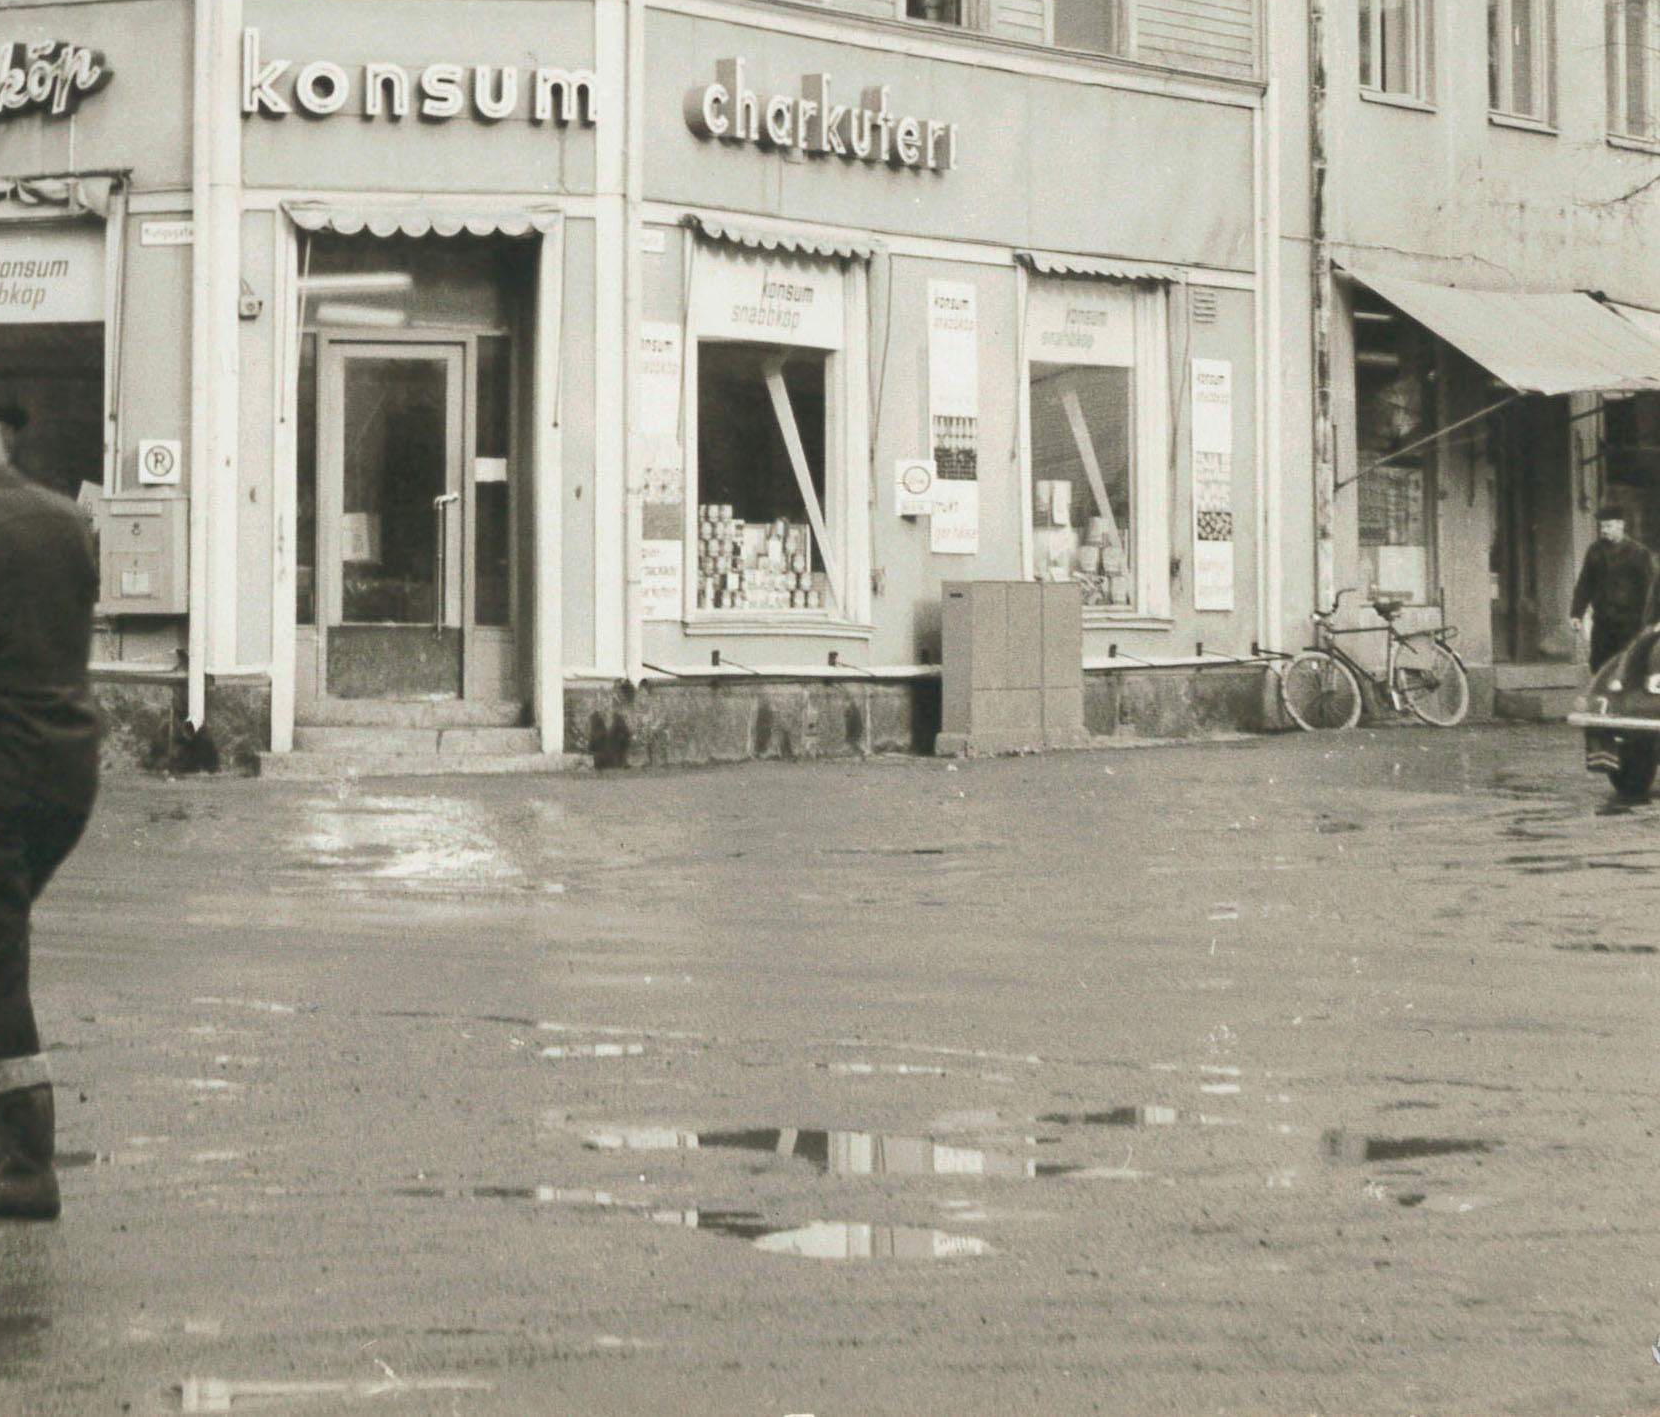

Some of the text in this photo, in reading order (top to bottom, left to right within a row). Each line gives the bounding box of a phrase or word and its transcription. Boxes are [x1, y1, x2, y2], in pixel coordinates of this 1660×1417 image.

[240, 26, 597, 124] konsum
[698, 57, 960, 170] charkuteri
[762, 268, 814, 303] konsum
[933, 290, 969, 311] konsum
[1065, 302, 1108, 327] konsum
